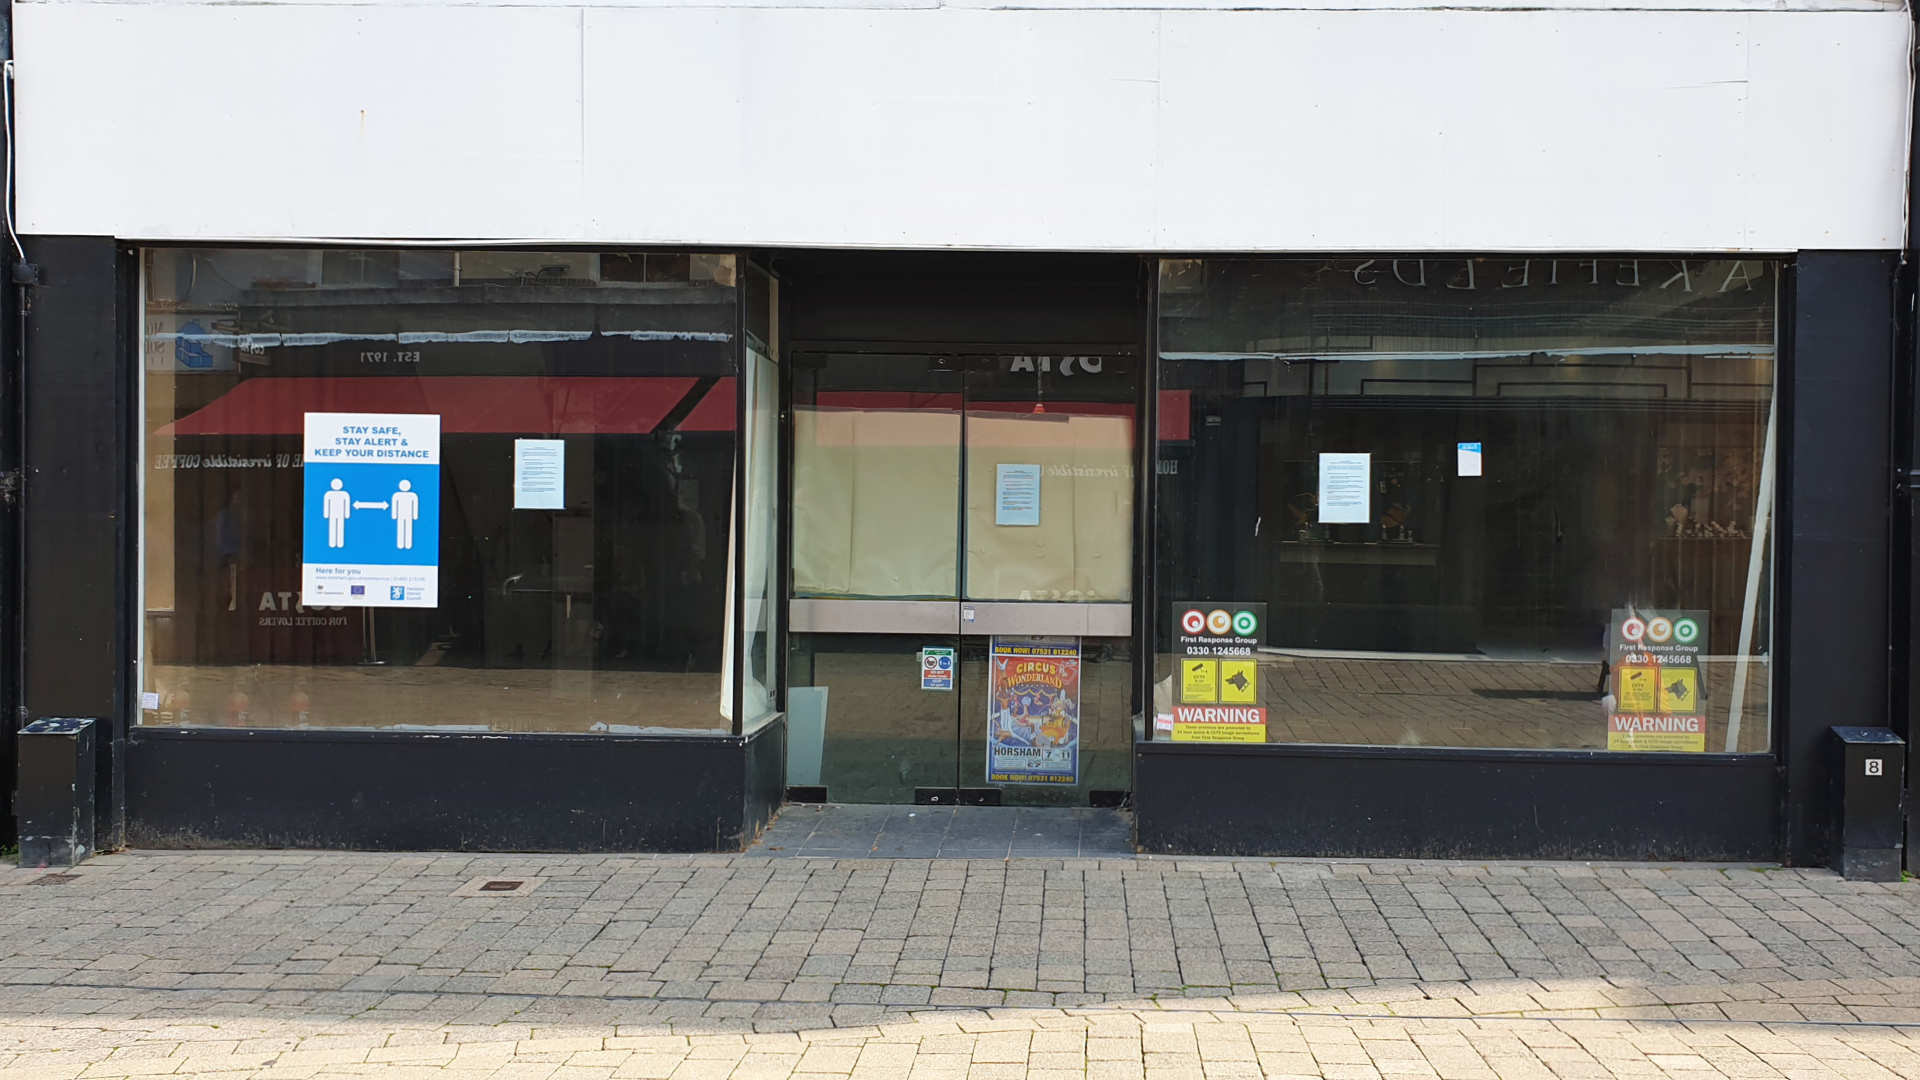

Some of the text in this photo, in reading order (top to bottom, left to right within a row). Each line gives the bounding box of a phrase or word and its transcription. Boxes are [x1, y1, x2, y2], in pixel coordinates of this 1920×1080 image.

[342, 426, 401, 436] STAY SAFE,
[364, 438, 398, 446] ALERT
[377, 450, 429, 458] DISTANCE
[1235, 637, 1257, 645] Group
[1187, 646, 1251, 655] 0330 1245668
[1675, 645, 1698, 653] Group
[1626, 654, 1691, 664] 0330 1245668
[1016, 662, 1056, 675] CIRCUS
[1008, 673, 1062, 689] WONDERLAND
[1178, 708, 1260, 723] WARNING
[1614, 717, 1699, 732] WARNING
[994, 747, 1041, 757] HORSHAM
[1869, 761, 1879, 773] 8
